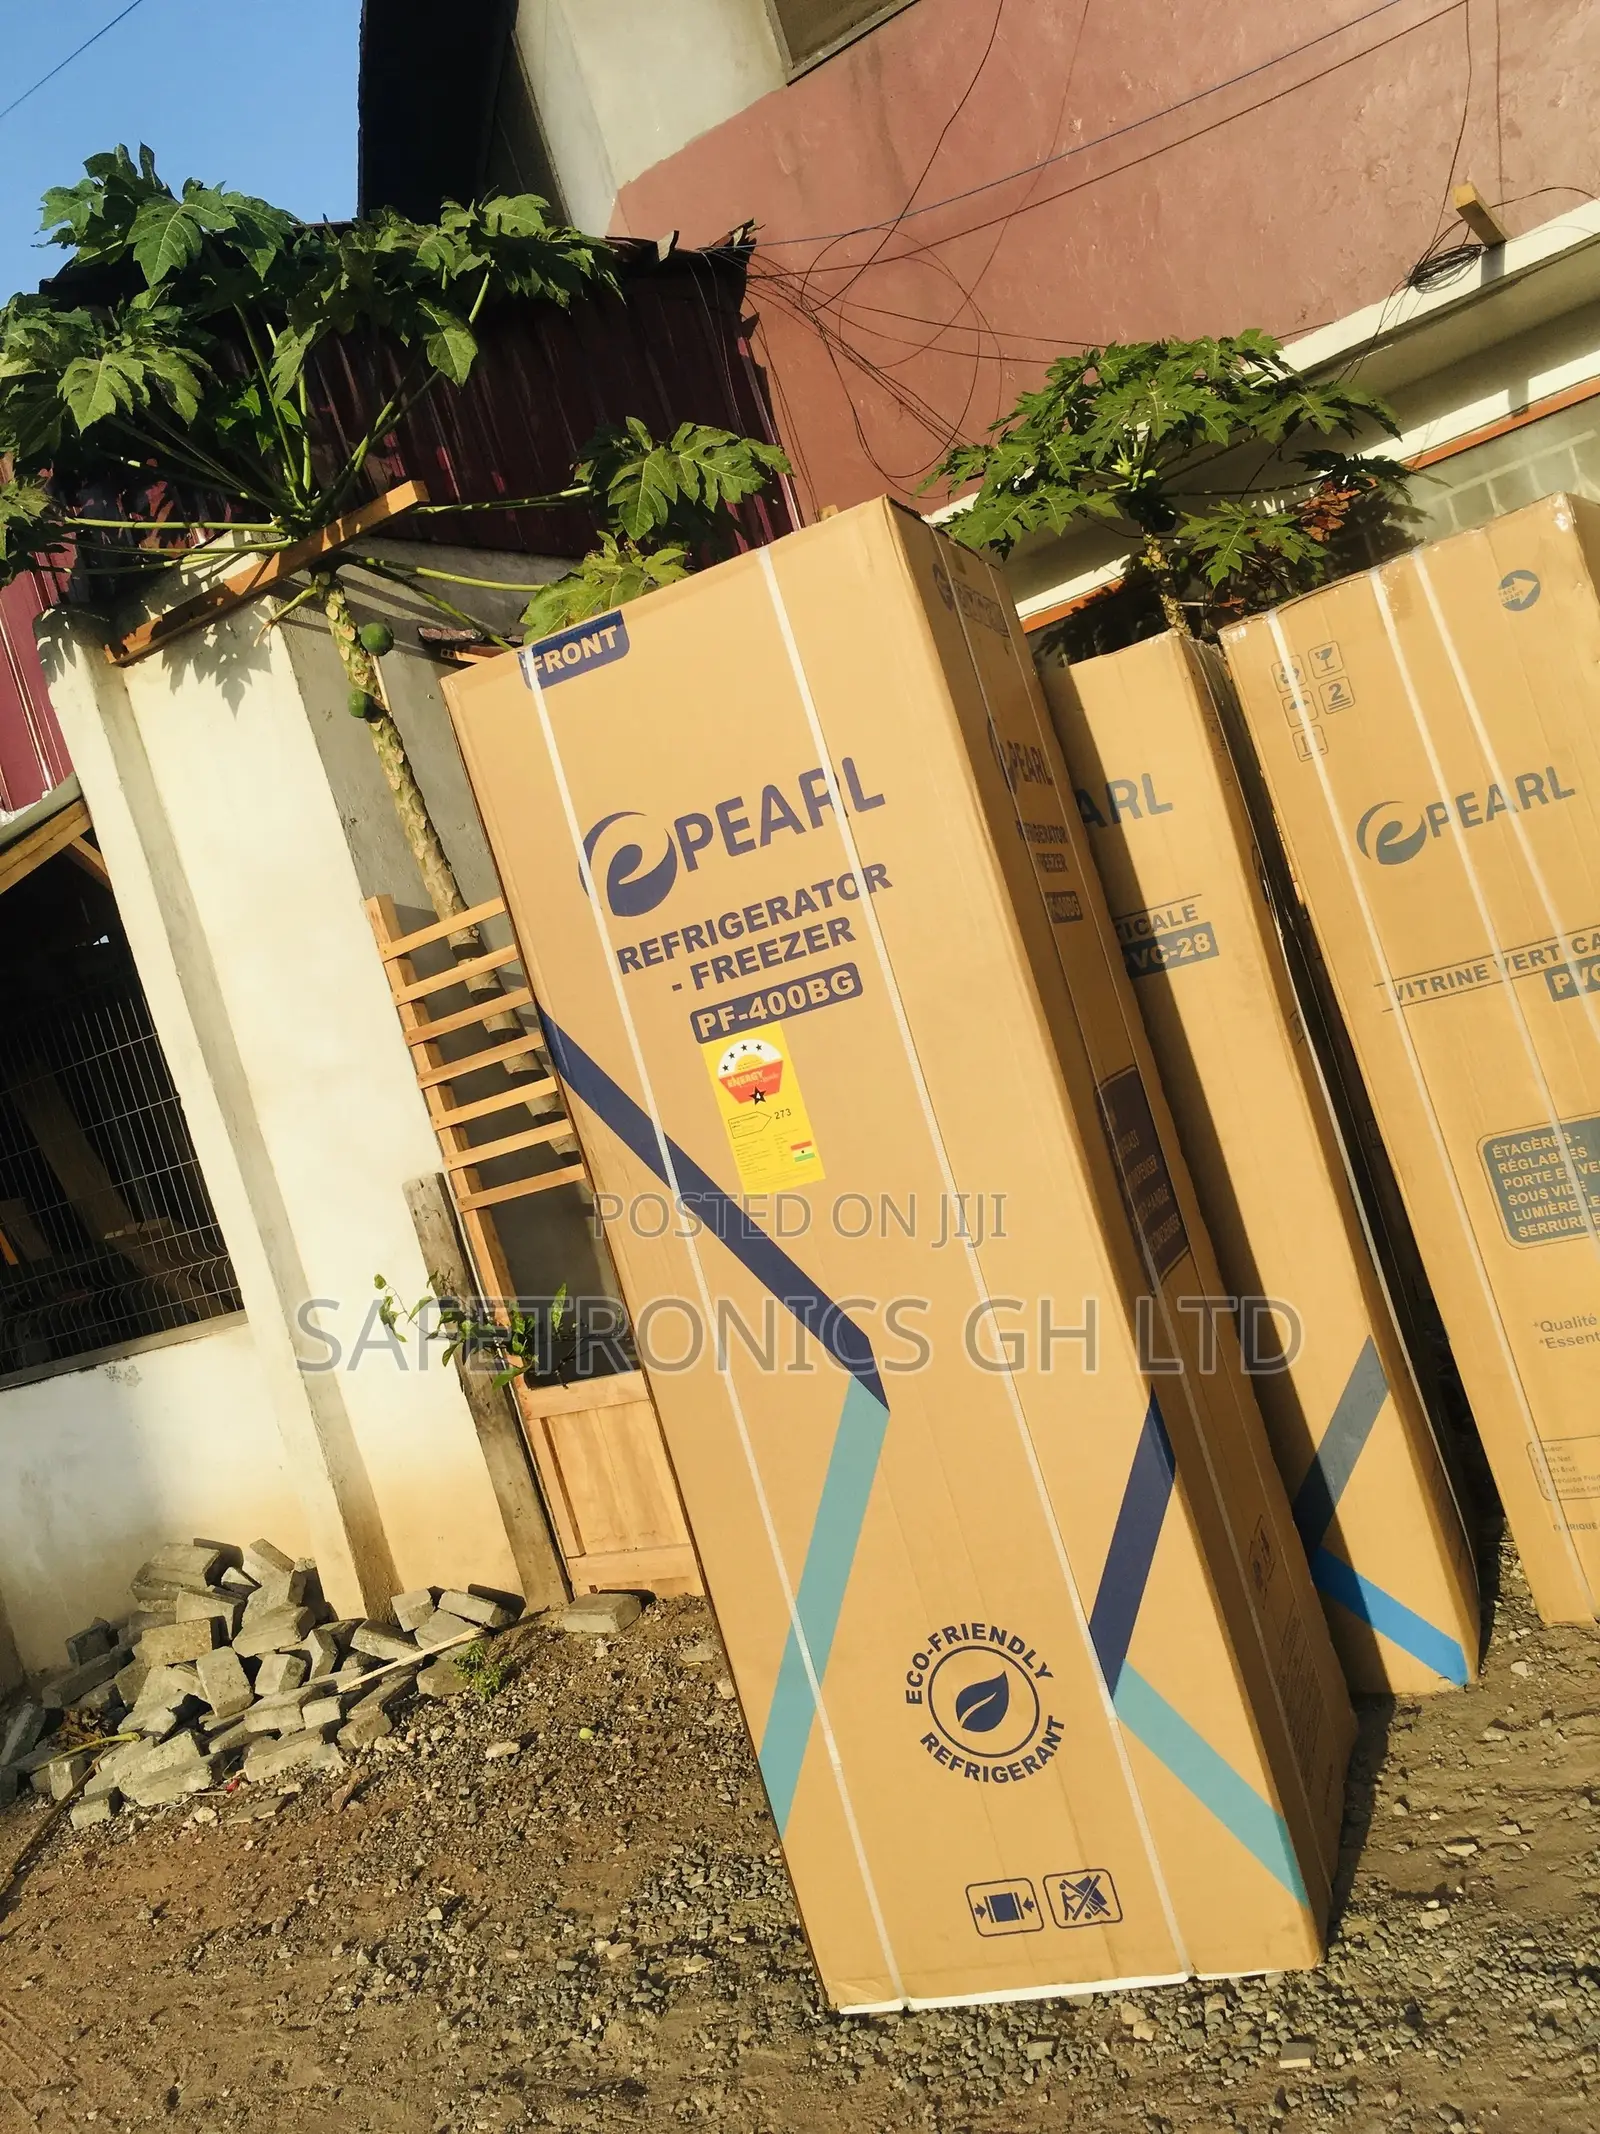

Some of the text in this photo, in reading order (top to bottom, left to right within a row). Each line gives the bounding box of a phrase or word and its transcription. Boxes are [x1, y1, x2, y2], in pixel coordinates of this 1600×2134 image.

[533, 626, 617, 674] FRONT
[671, 757, 887, 873] PEARL
[1425, 766, 1576, 839] PEARL
[616, 862, 893, 976] REFRIGERATOR
[689, 916, 857, 991] FREEZER
[696, 972, 857, 1037] PF-400BG
[774, 1108, 792, 1120] 273
[1502, 1170, 1553, 1190] PORTE
[1578, 1160, 1600, 1175] VE
[1508, 1180, 1588, 1206] SOUS VIDE
[1512, 1199, 1580, 1222] LUMIÈRE
[1553, 1522, 1598, 1531] FRIQUE
[906, 1623, 1054, 1704] ECO-FRIENDLY
[920, 1715, 1065, 1783] REFRIGERANT
